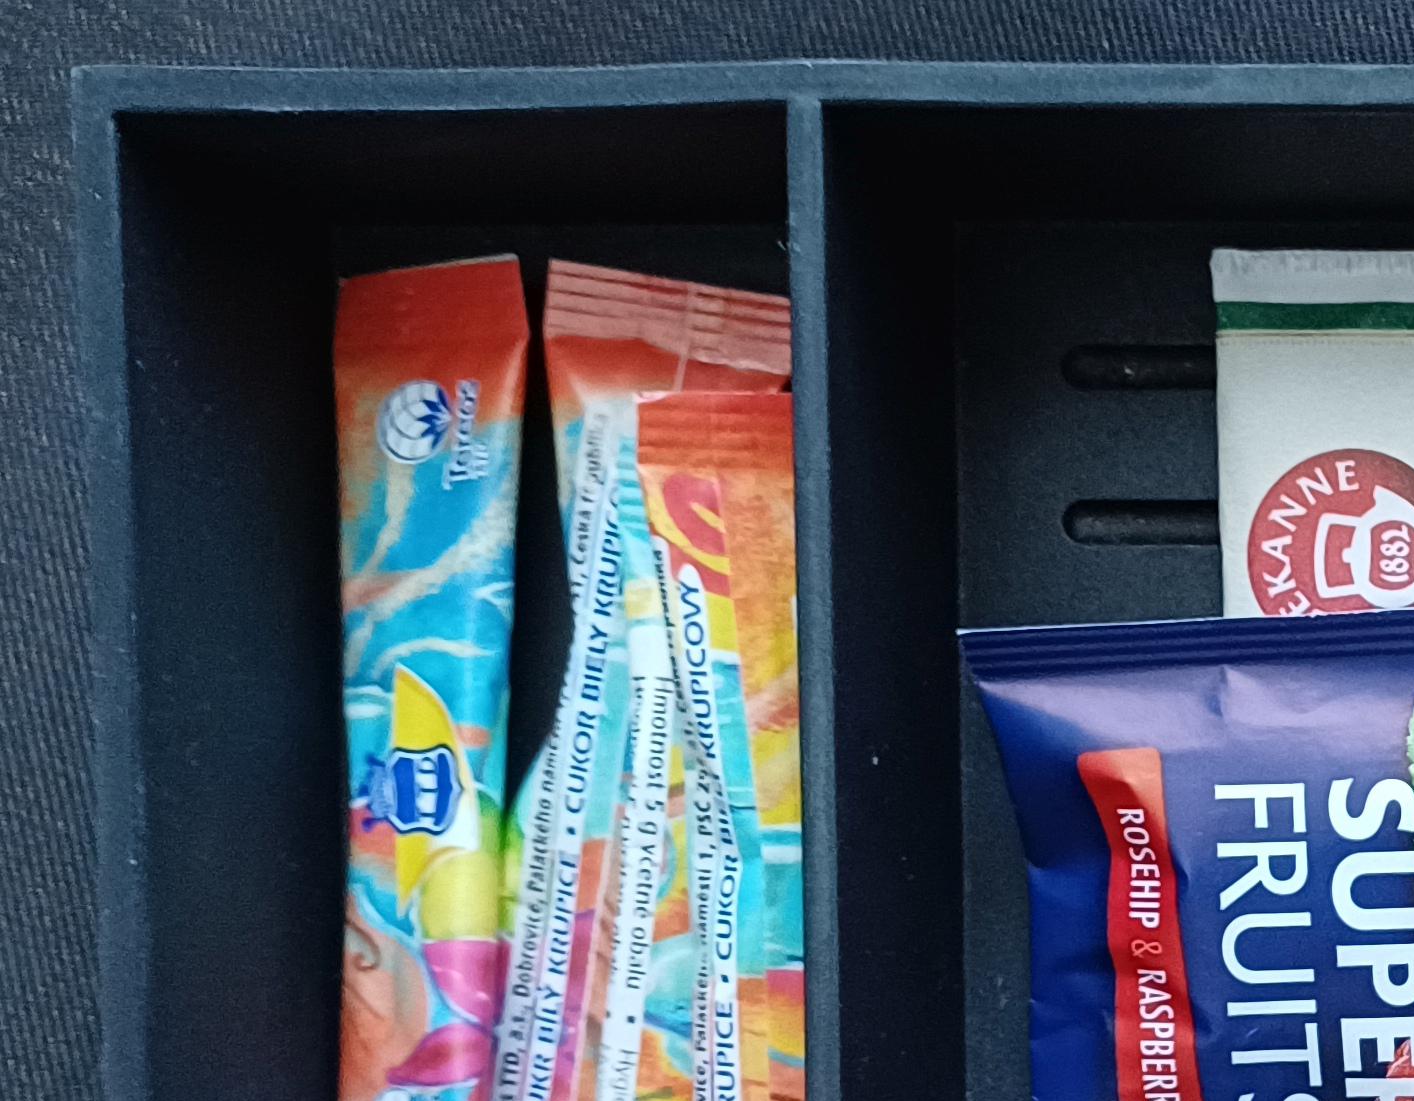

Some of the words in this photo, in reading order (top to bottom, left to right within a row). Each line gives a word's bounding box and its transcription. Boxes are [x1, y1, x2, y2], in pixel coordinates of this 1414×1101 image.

[1379, 525, 1410, 582] 1882
[564, 710, 597, 814] CUKOR
[637, 820, 659, 837] g
[1116, 807, 1162, 930] ROSEHIP
[715, 854, 739, 961] CUKOR
[625, 926, 650, 990] obalu
[1131, 938, 1163, 958] &
